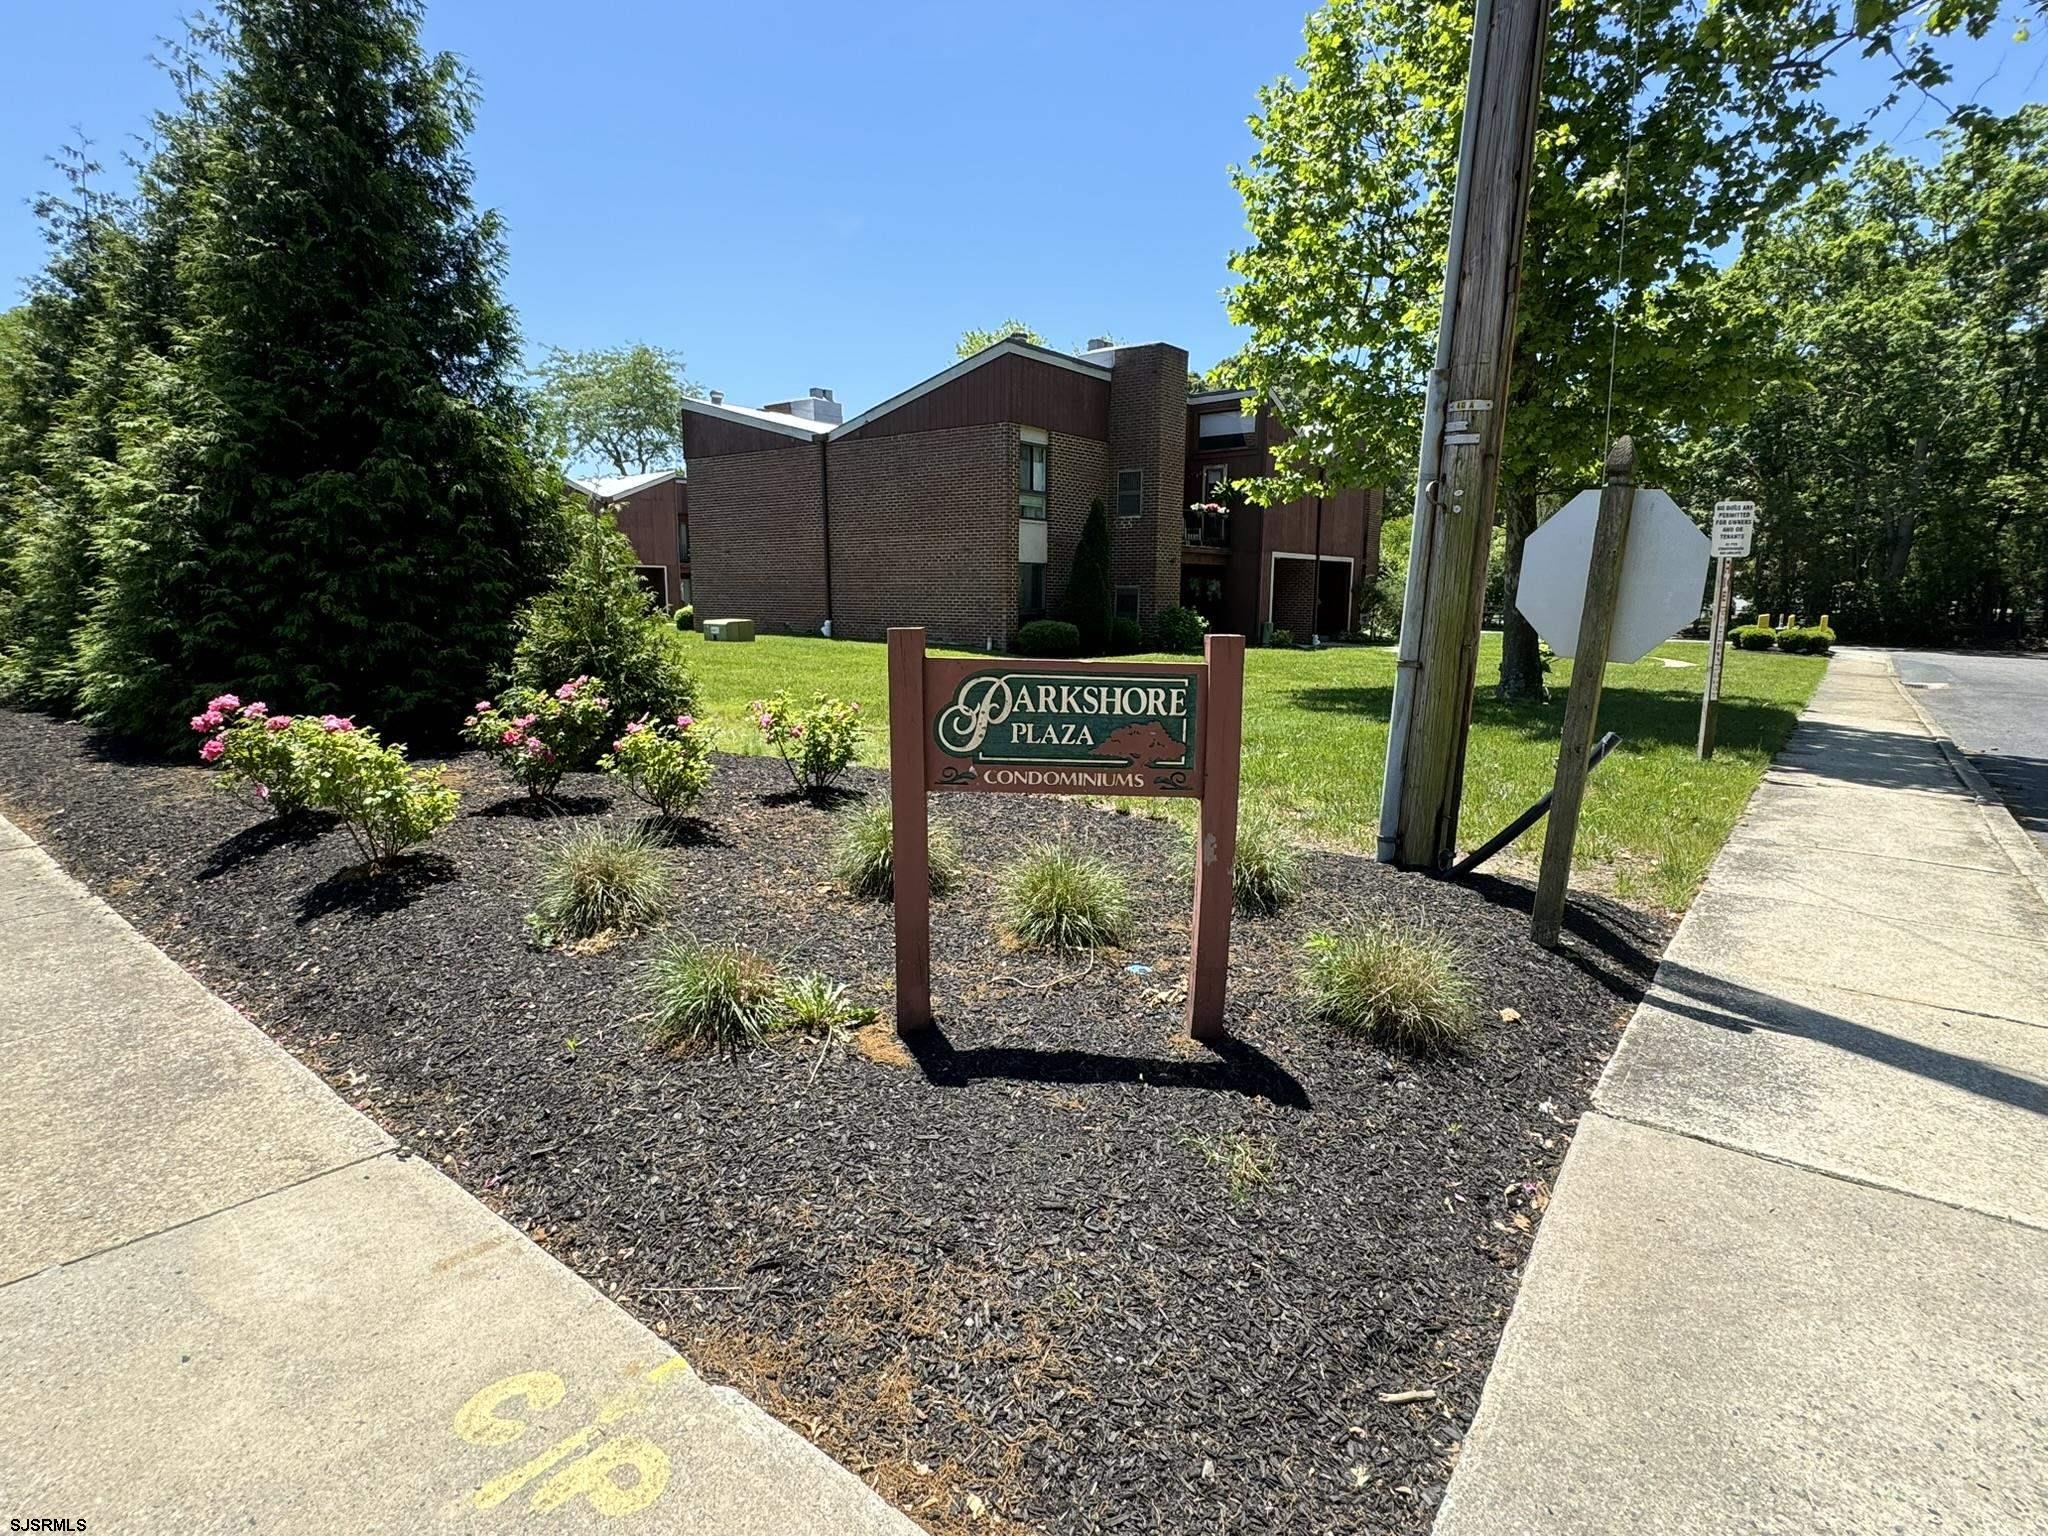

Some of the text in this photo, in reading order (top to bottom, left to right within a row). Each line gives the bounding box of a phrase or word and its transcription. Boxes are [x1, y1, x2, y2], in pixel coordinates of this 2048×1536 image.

[938, 676, 1187, 752] PARKSHORE
[1010, 722, 1095, 745] PLAZA
[983, 769, 1145, 788] CONDOMINIUMS
